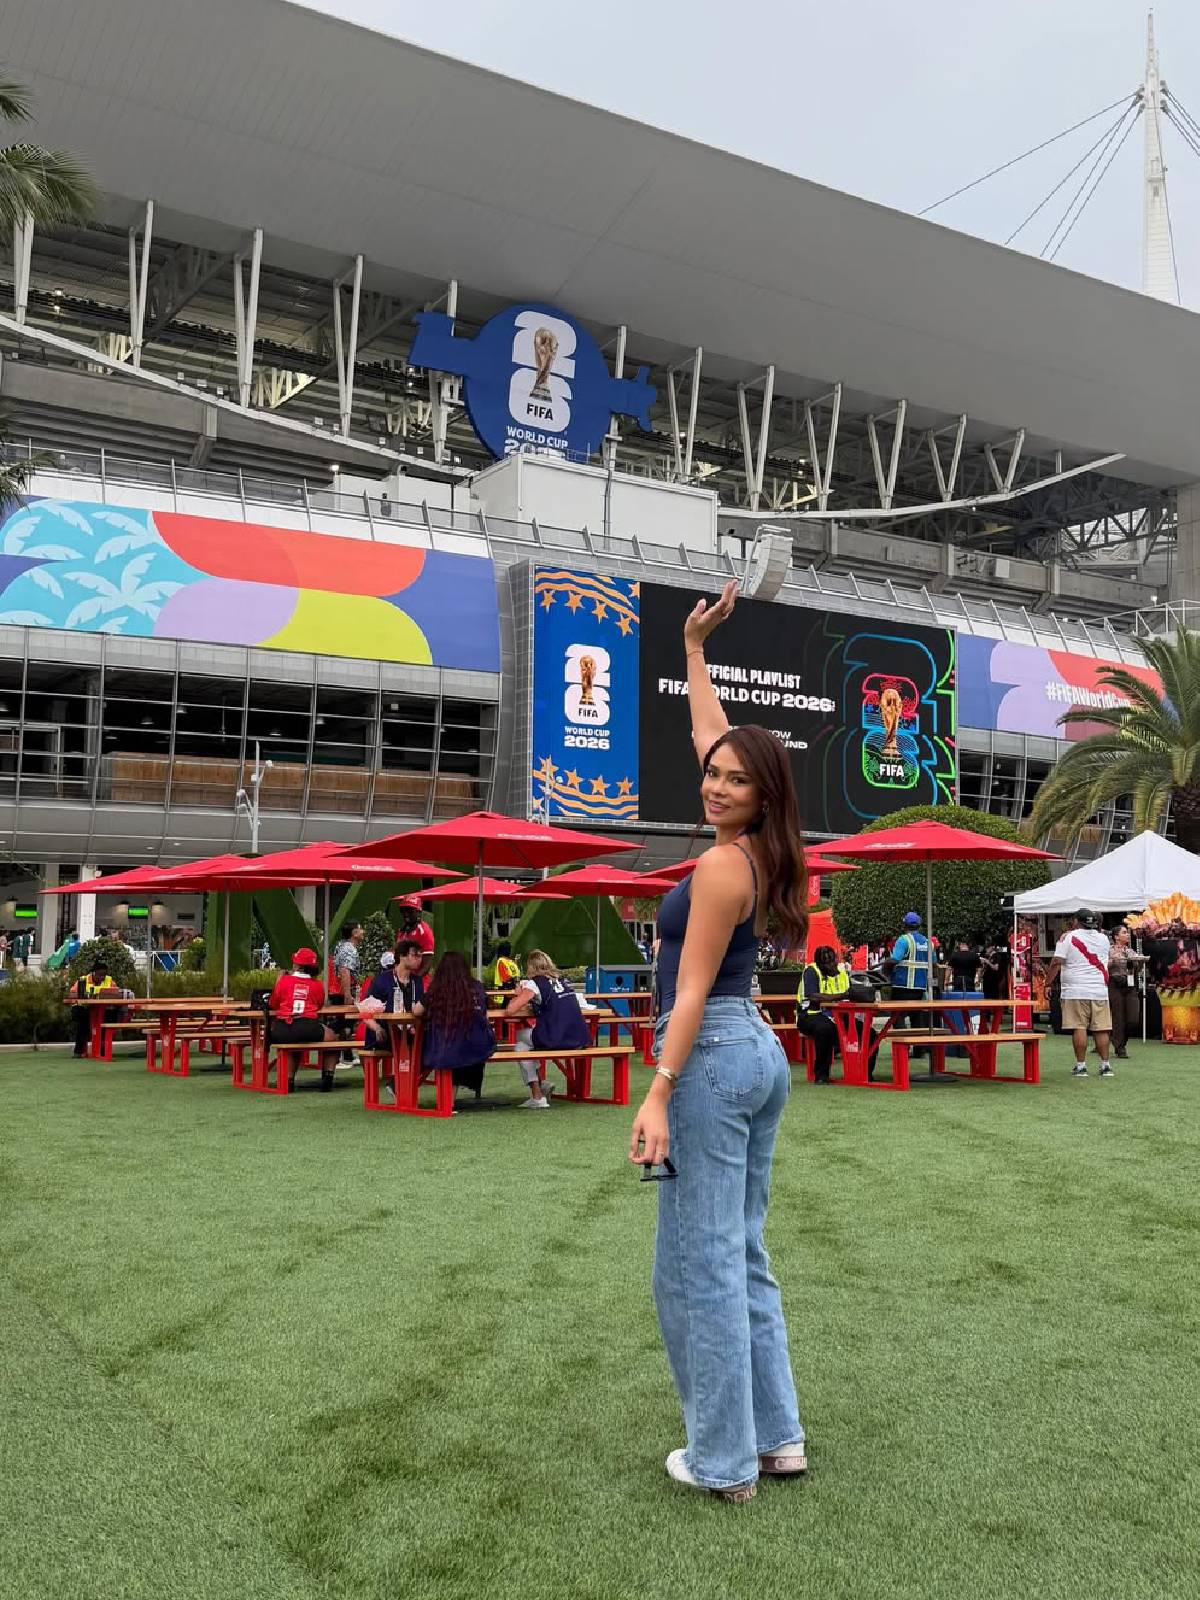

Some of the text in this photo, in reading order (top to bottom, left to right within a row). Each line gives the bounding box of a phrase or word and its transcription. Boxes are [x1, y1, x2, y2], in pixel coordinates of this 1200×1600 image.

[526, 403, 553, 420] FIFA
[506, 425, 568, 449] WORLD CUP
[706, 664, 801, 689] FFICIAL PLAYLIST
[658, 678, 689, 695] FIFA
[711, 684, 750, 701] ORLD
[751, 689, 781, 706] CUP
[578, 707, 598, 718] FIFA
[564, 725, 610, 737] WORLD CUP
[564, 735, 610, 750] 2026
[879, 763, 904, 777] FIFA
